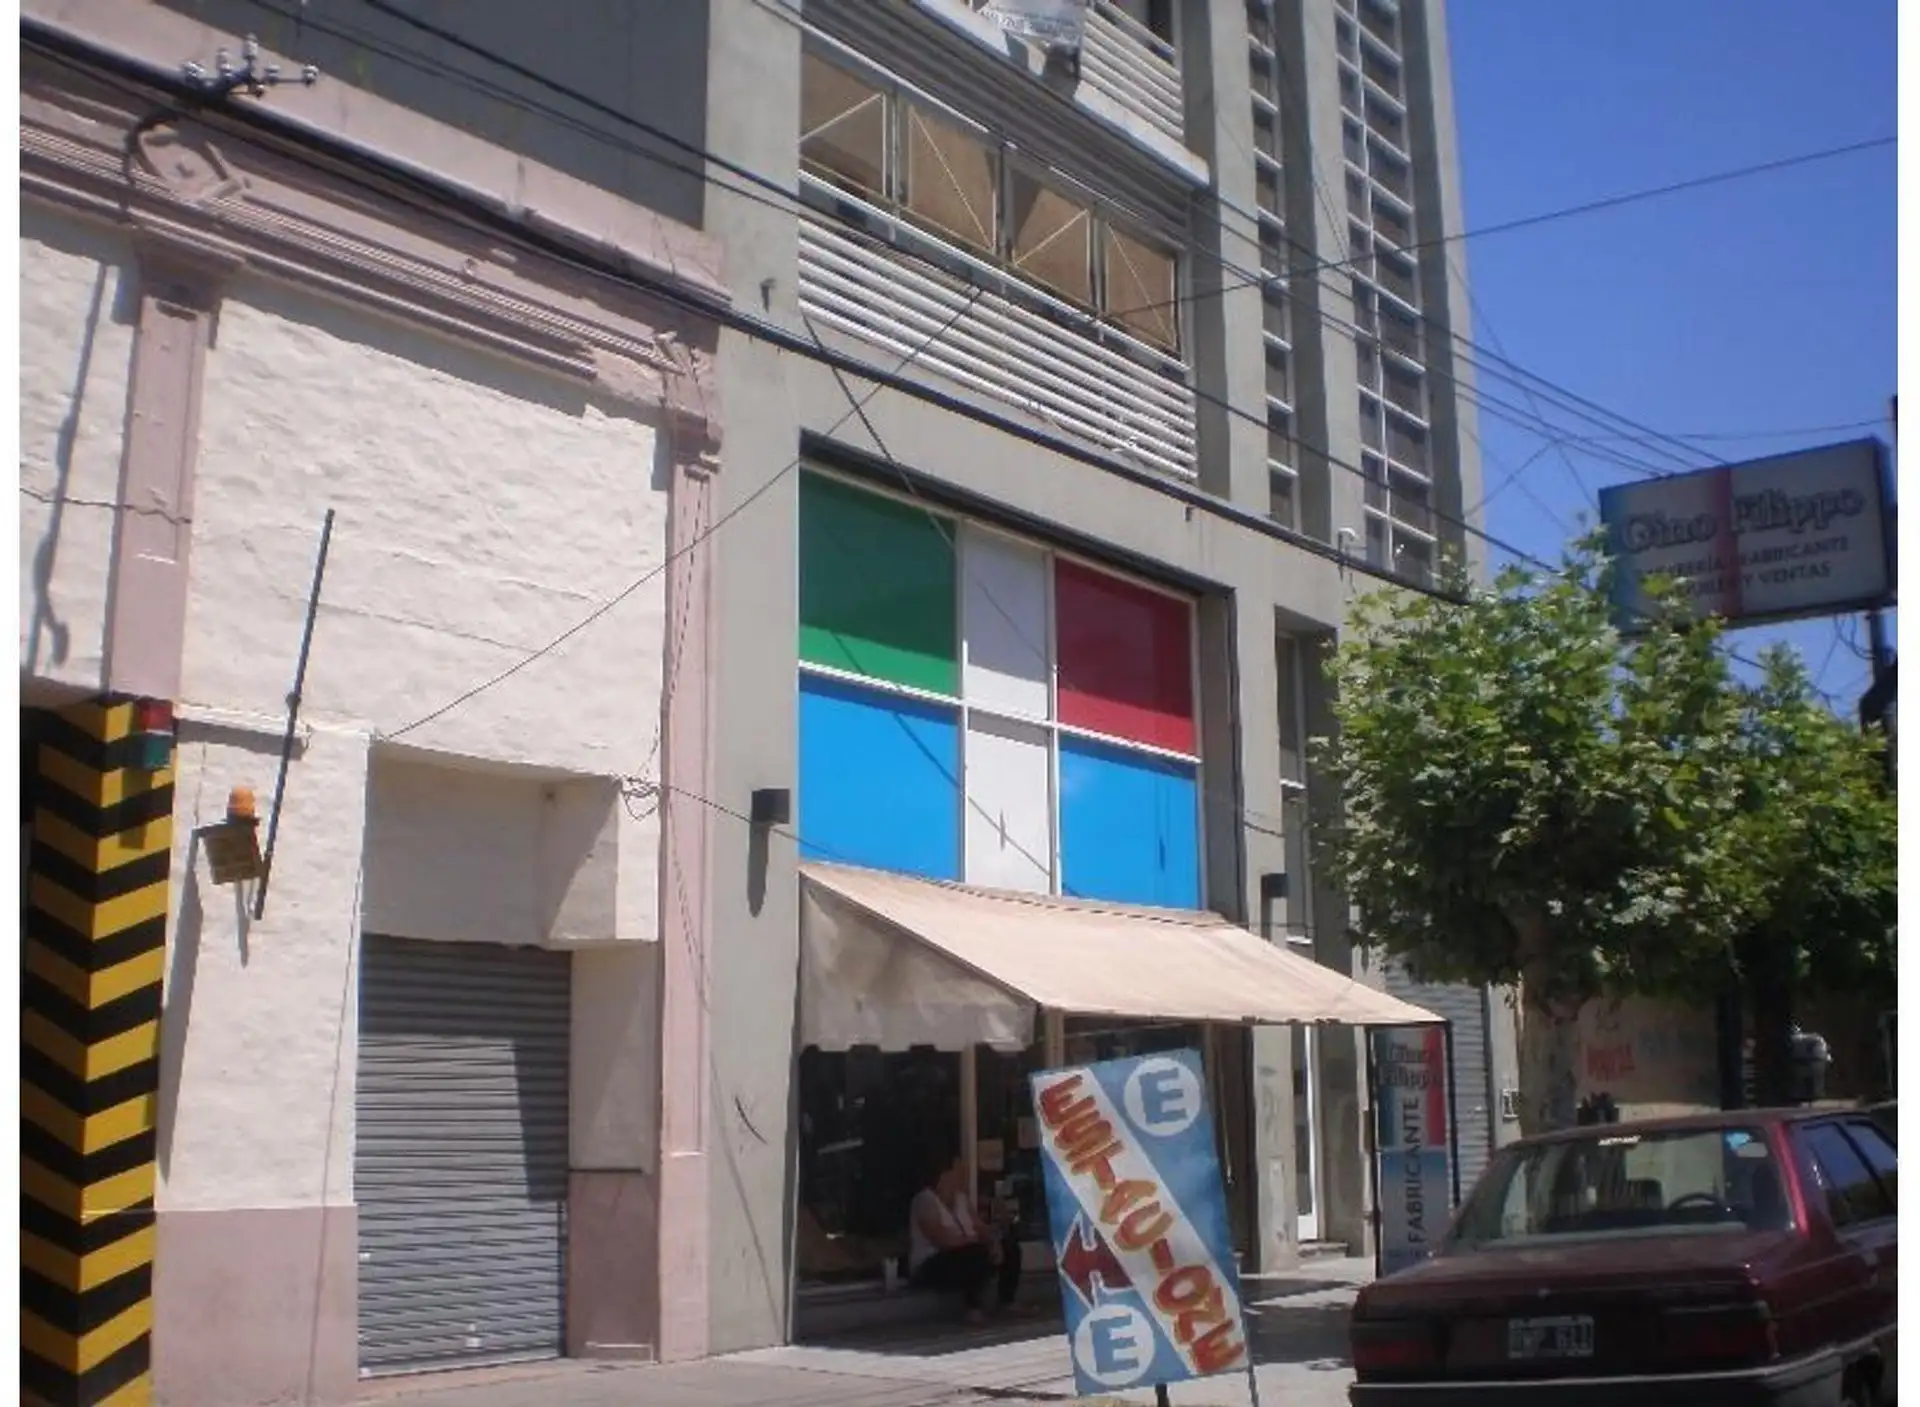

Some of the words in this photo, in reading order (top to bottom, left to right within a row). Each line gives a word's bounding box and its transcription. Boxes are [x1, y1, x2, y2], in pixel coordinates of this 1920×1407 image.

[1138, 1067, 1188, 1125] E
[1402, 1096, 1427, 1244] FABRICANTE
[1090, 1312, 1140, 1373] E
